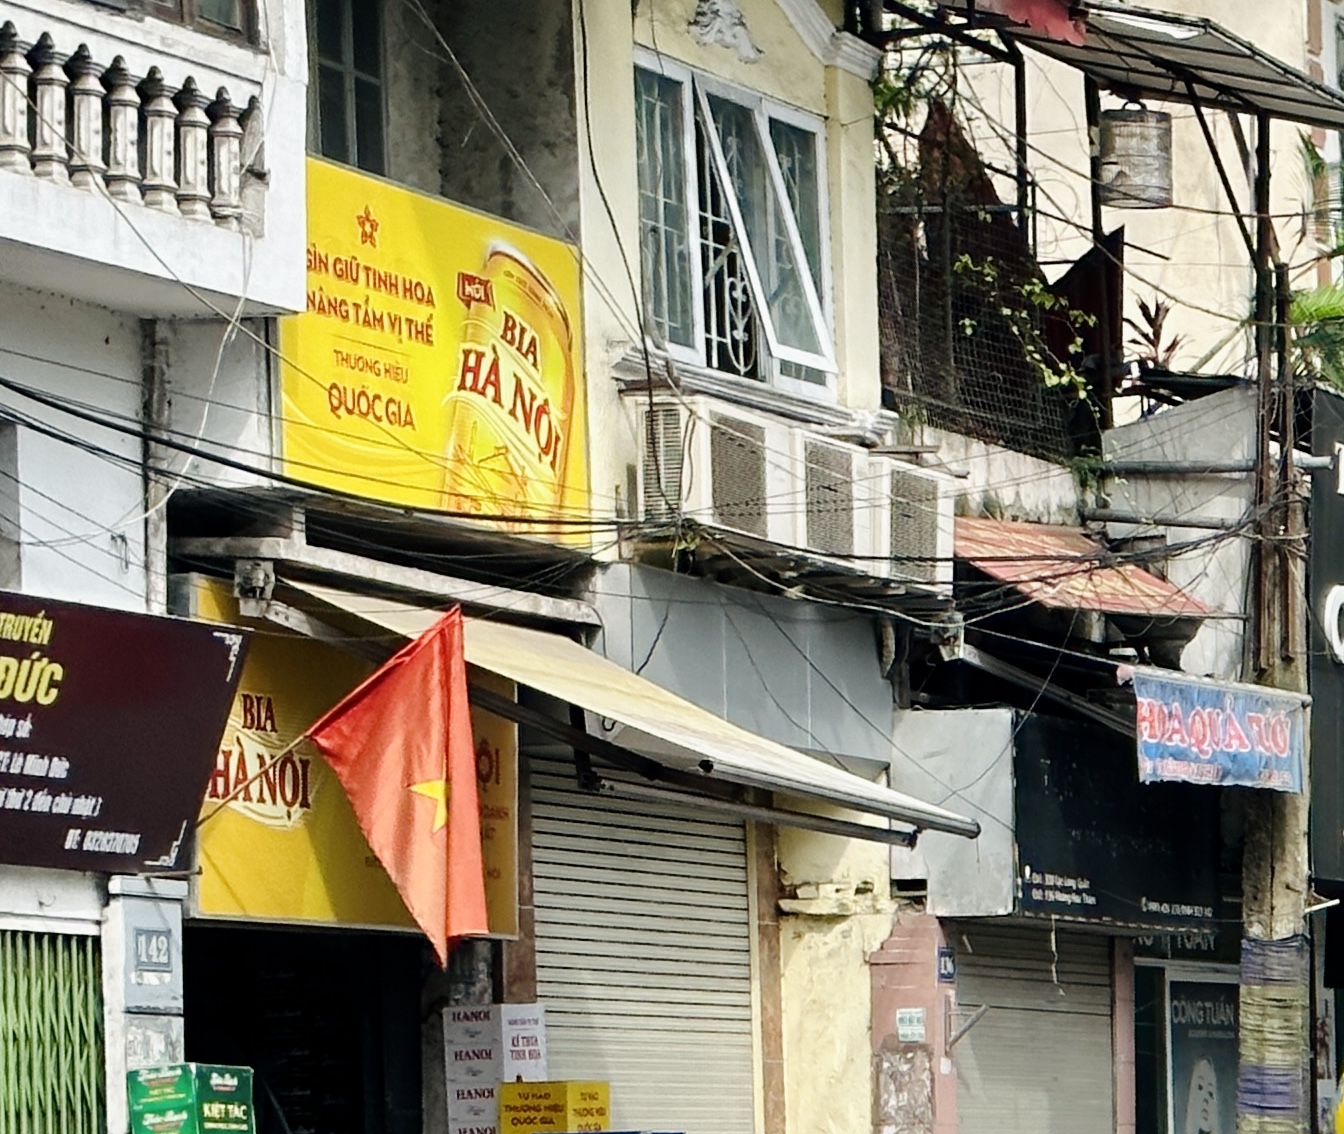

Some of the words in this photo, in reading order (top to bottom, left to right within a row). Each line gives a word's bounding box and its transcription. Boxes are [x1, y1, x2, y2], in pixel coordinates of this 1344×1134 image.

[307, 286, 350, 321] NÂNG
[363, 267, 399, 296] TINH
[403, 277, 436, 309] HOA
[500, 310, 541, 373] BIA
[328, 381, 384, 425] QUỐC
[385, 398, 416, 433] GIA
[457, 342, 505, 408] HÀ
[508, 372, 562, 473] NỘI
[241, 693, 278, 734] BIA
[209, 733, 251, 802] HÀ
[137, 934, 169, 963] 142
[454, 1049, 493, 1061] HANOI
[203, 1102, 226, 1120] KIỆT
[227, 1102, 247, 1120] TÁC
[456, 1088, 494, 1100] HANOI
